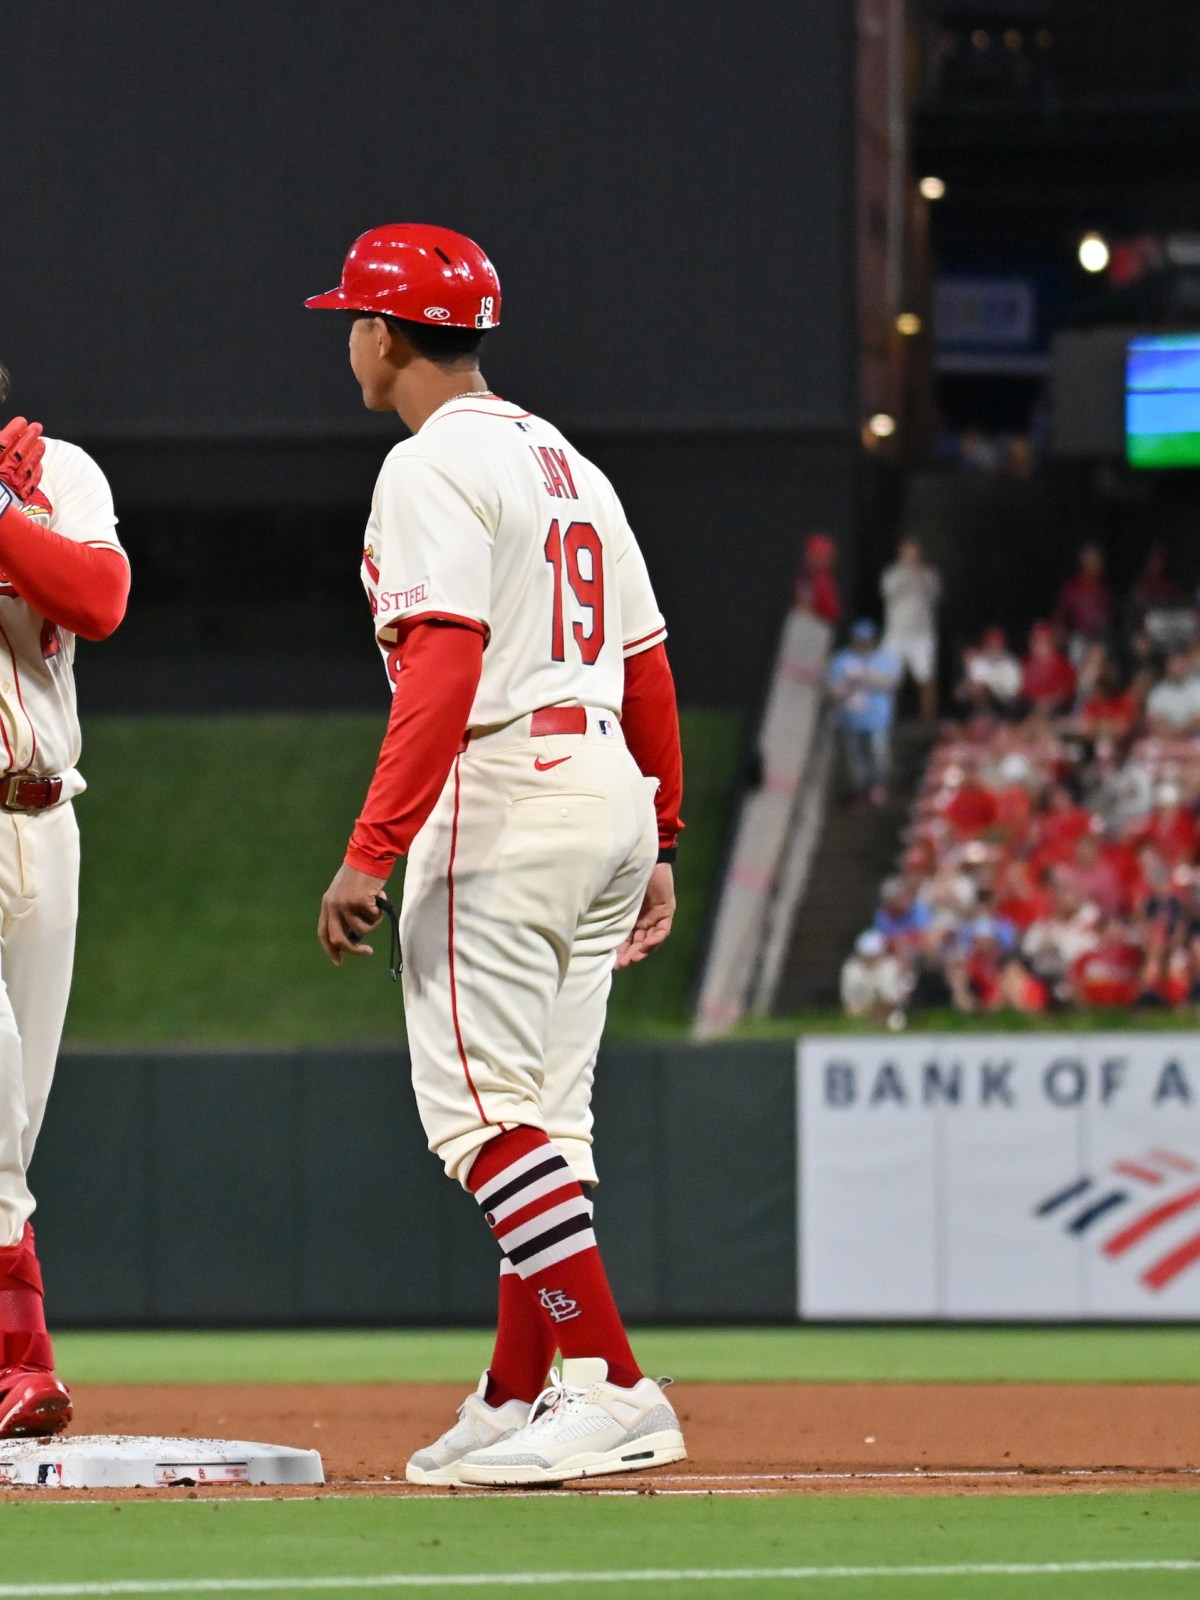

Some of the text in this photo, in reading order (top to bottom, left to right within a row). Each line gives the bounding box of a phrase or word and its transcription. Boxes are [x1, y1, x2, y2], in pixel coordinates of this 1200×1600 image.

[480, 296, 495, 316] 19
[528, 445, 579, 500] JAY
[380, 583, 429, 612] STIFEL
[543, 518, 606, 667] 19
[823, 1060, 1015, 1108] BANK
[1043, 1057, 1127, 1108] OF
